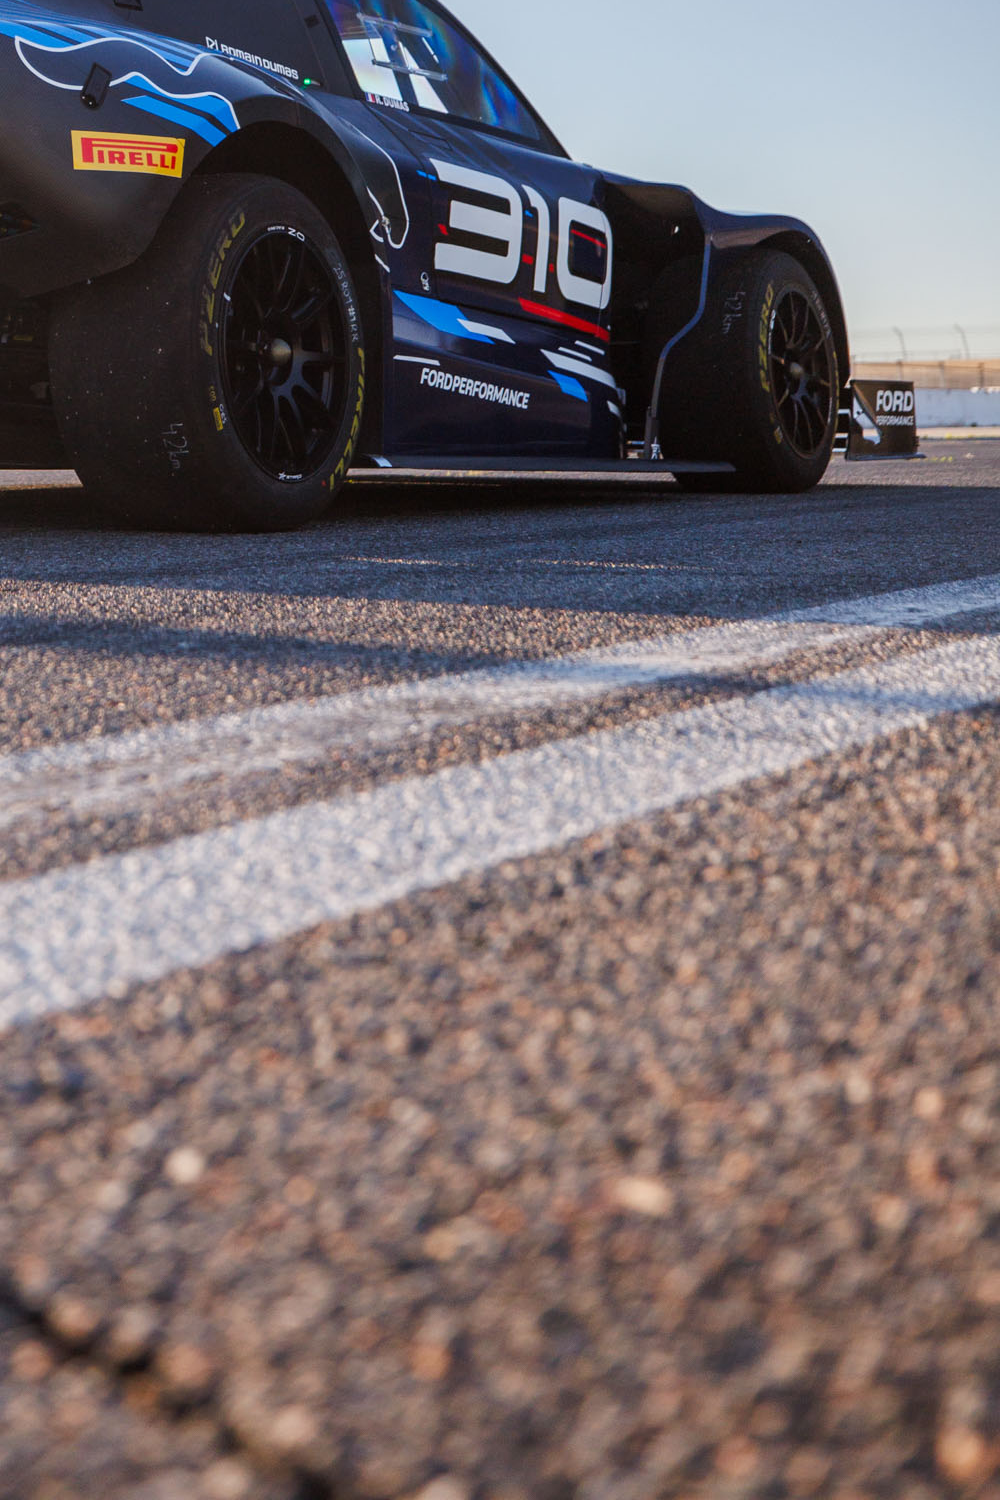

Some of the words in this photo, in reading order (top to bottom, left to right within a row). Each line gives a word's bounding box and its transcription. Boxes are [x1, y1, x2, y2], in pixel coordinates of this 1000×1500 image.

[383, 97, 410, 112] DUMAS
[80, 137, 178, 170] PIRELLI
[430, 158, 612, 309] 310
[875, 389, 915, 413] FORD
[875, 414, 915, 427] PERFORMANCE
